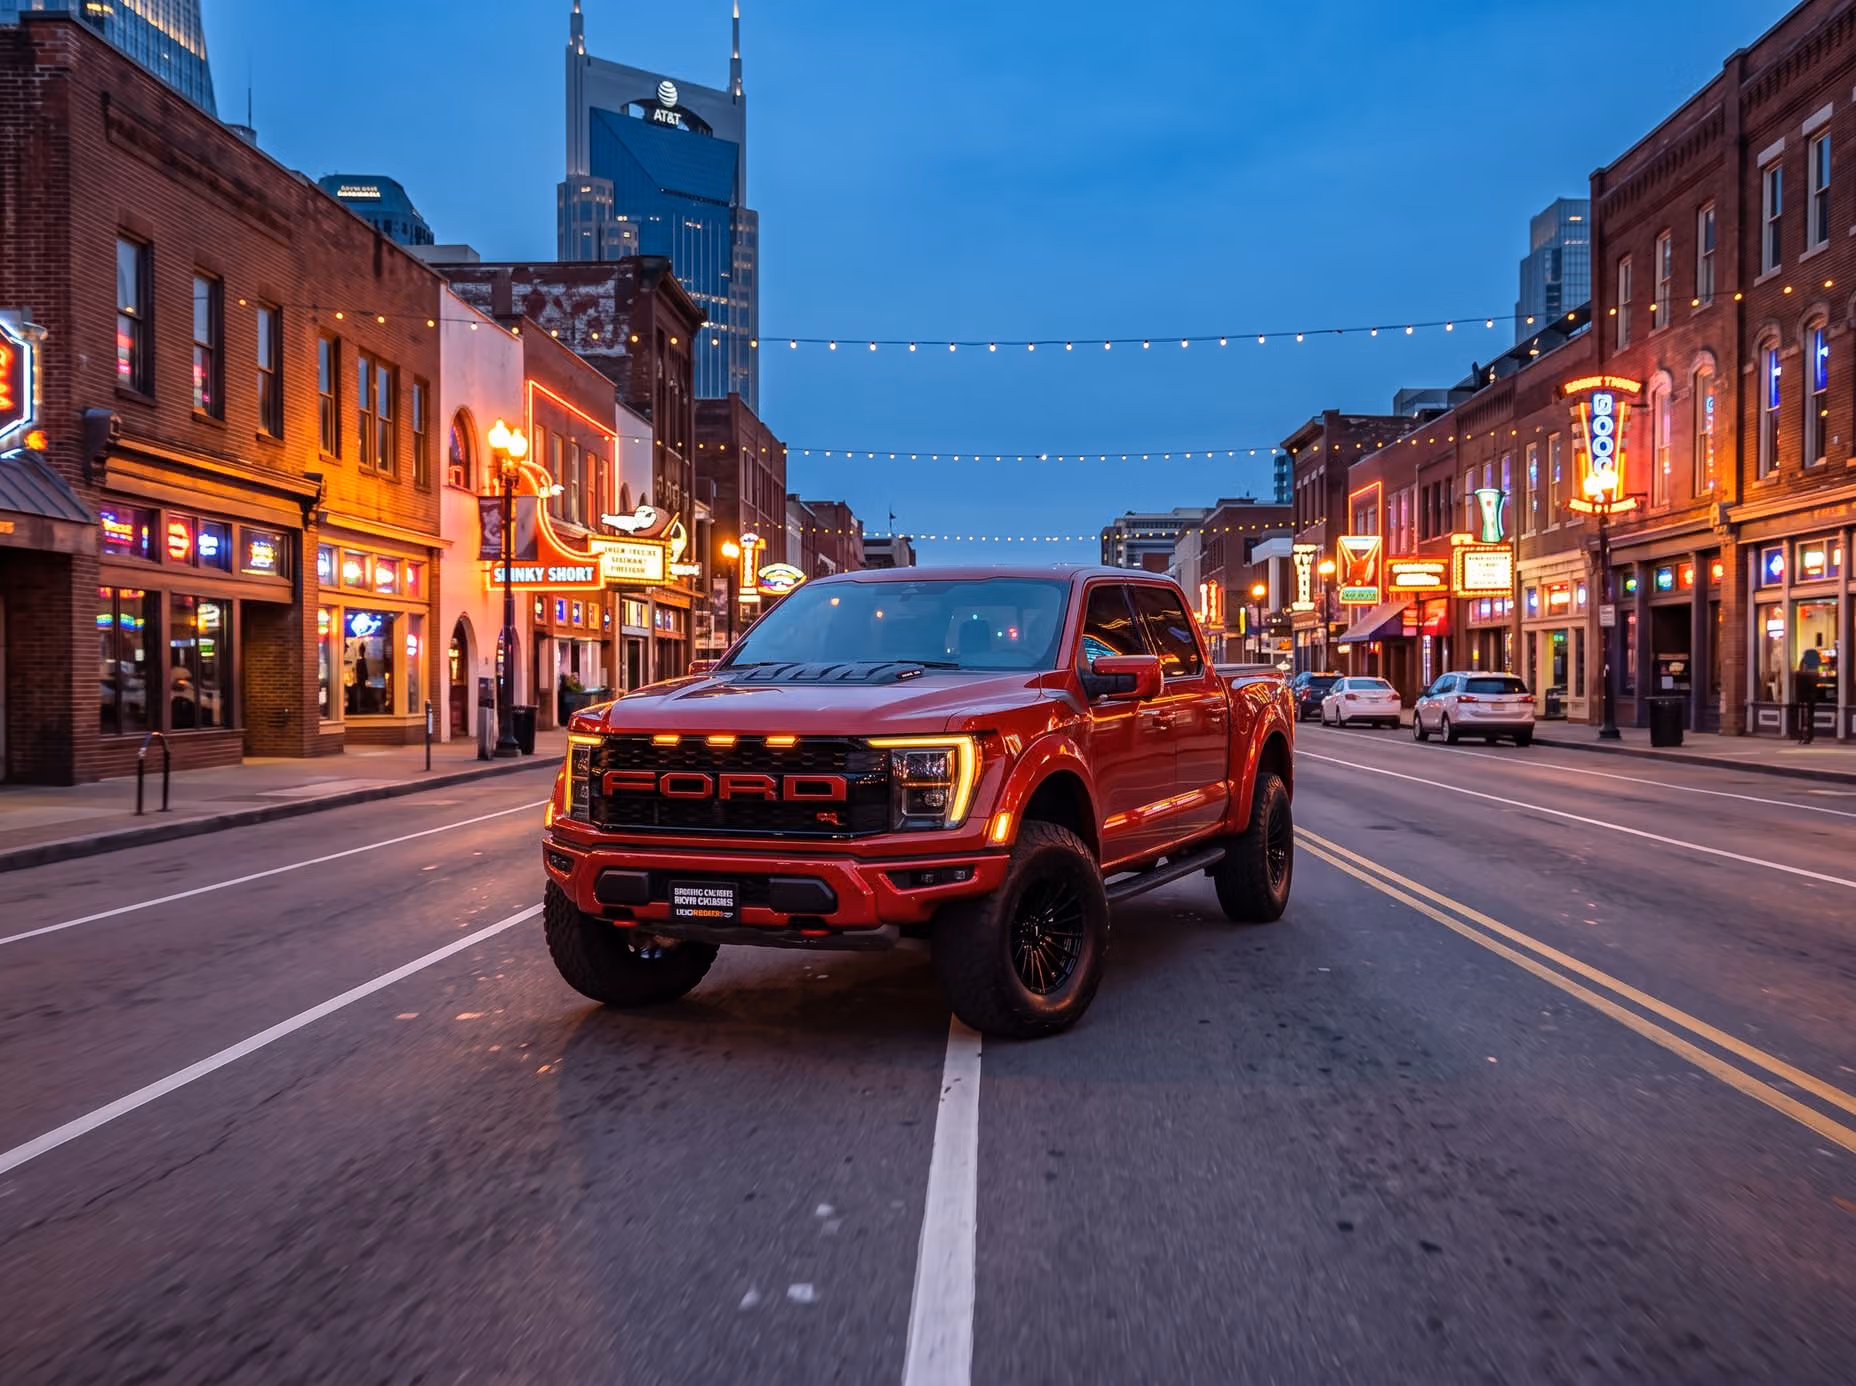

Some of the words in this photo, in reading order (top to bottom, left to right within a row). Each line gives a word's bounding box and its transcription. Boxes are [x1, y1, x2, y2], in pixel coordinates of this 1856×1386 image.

[654, 109, 682, 125] AT&T
[548, 566, 594, 582] SHORT
[602, 771, 847, 801] FORD
